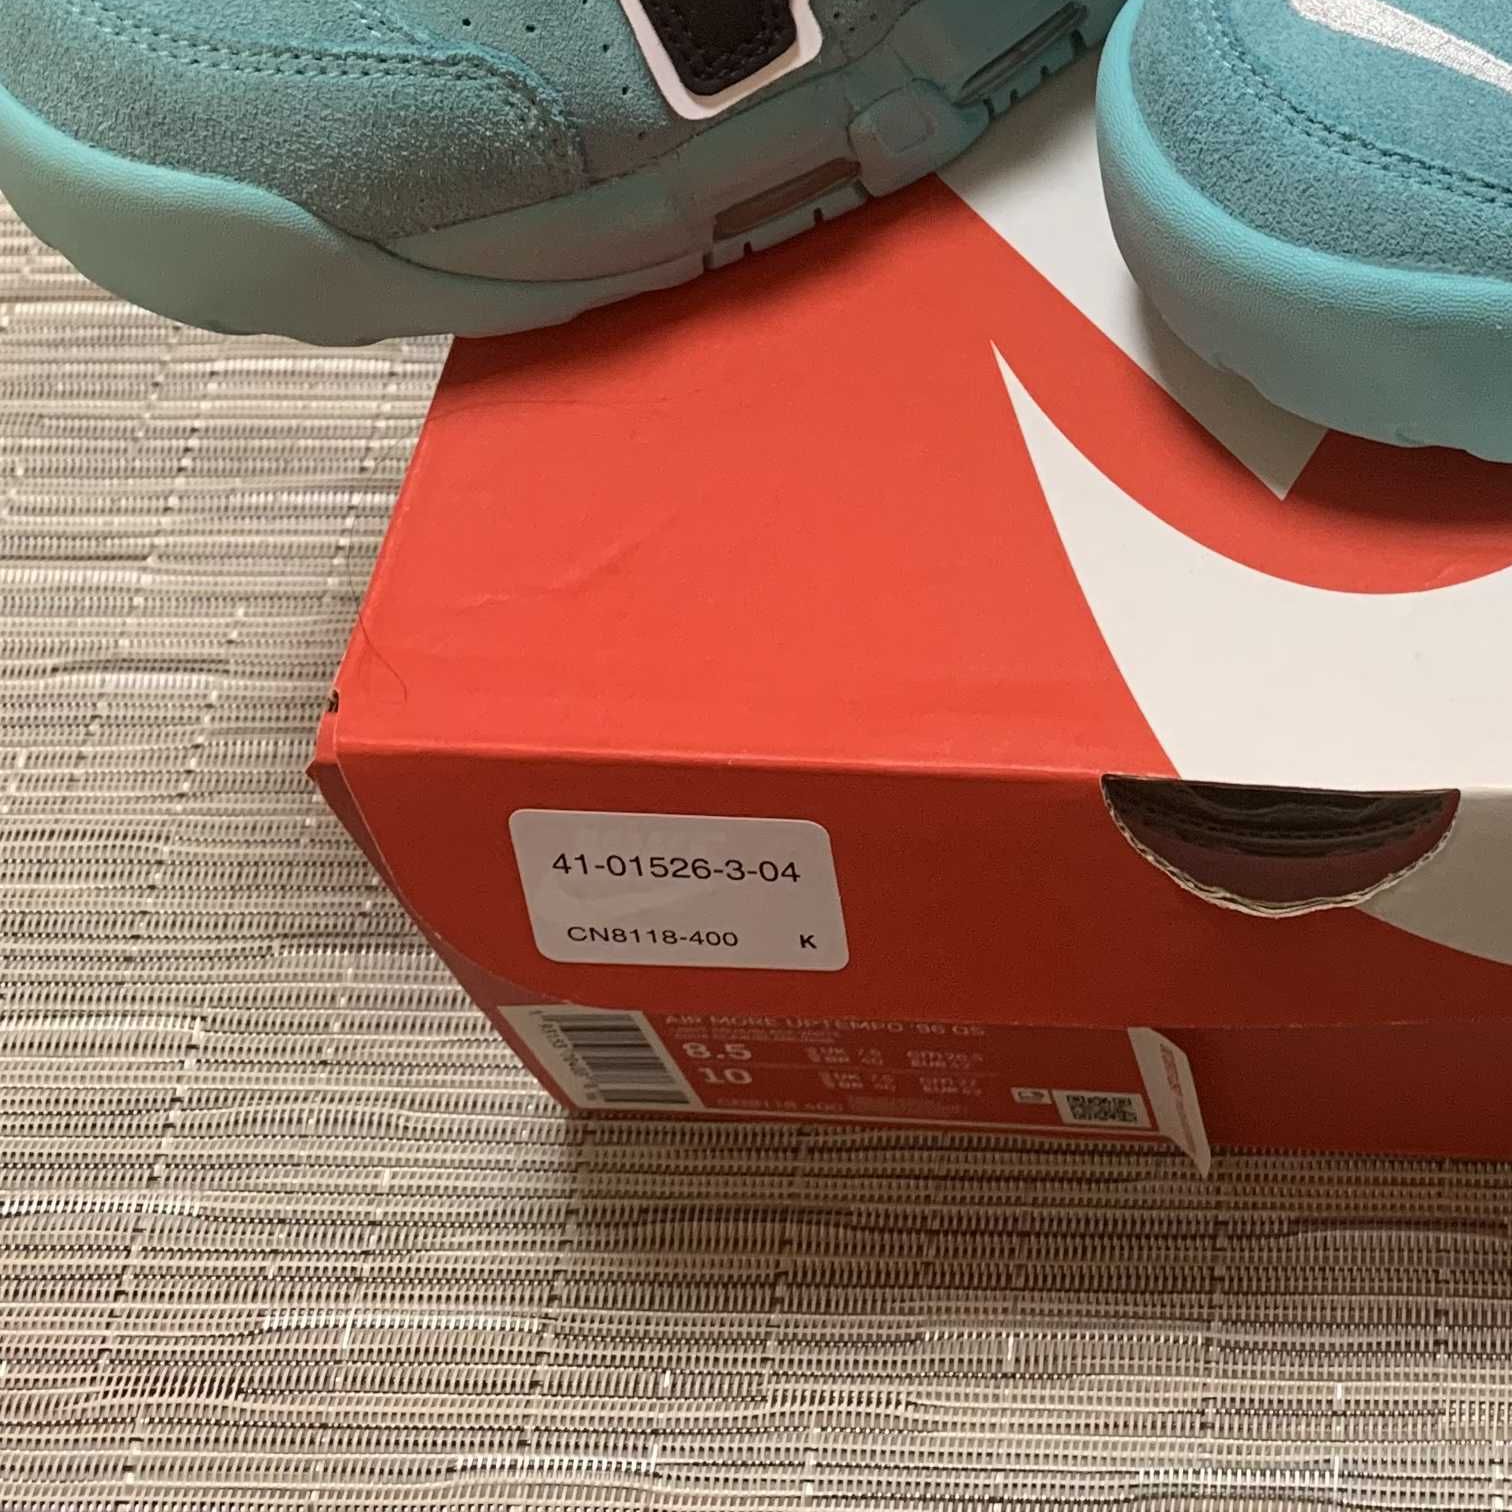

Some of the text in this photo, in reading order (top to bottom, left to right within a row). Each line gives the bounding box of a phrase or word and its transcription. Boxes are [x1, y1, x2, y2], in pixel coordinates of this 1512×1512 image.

[551, 853, 801, 883] 41-01526-3-04
[566, 926, 818, 950] CN8118-400 K
[682, 1041, 752, 1061] 8.5
[697, 1066, 752, 1085] 10
